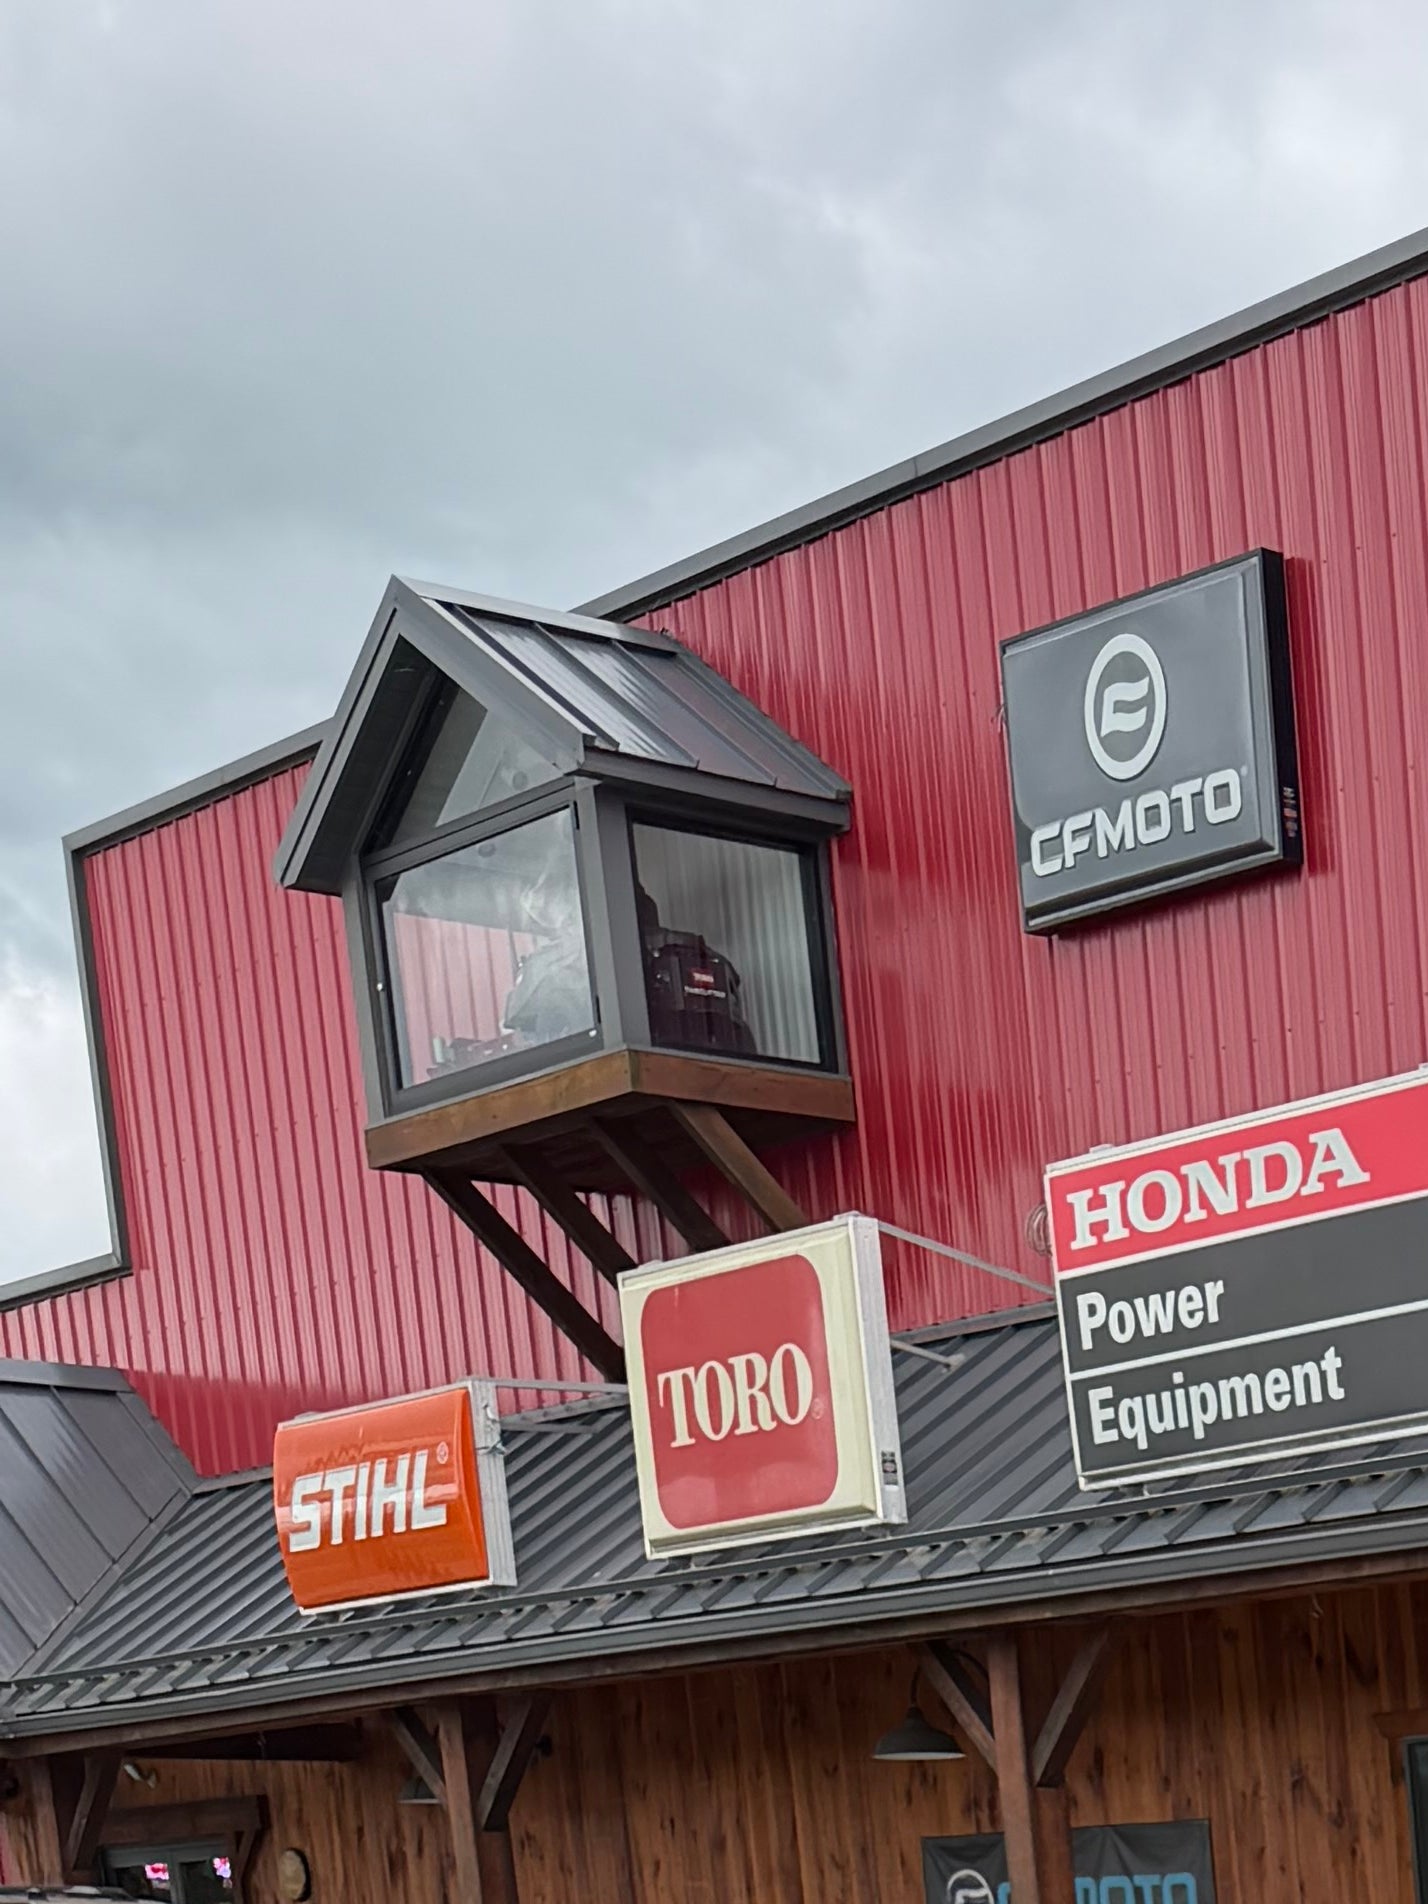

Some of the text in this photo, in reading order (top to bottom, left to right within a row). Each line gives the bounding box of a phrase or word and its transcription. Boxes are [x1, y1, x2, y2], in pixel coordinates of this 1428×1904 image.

[1030, 768, 1241, 878] CFMOTO
[1067, 1128, 1370, 1250] HONDA
[1077, 1280, 1225, 1351] Power
[657, 1343, 814, 1449] TORO
[1088, 1347, 1346, 1450] Equipment
[290, 1449, 447, 1553] STIHL
